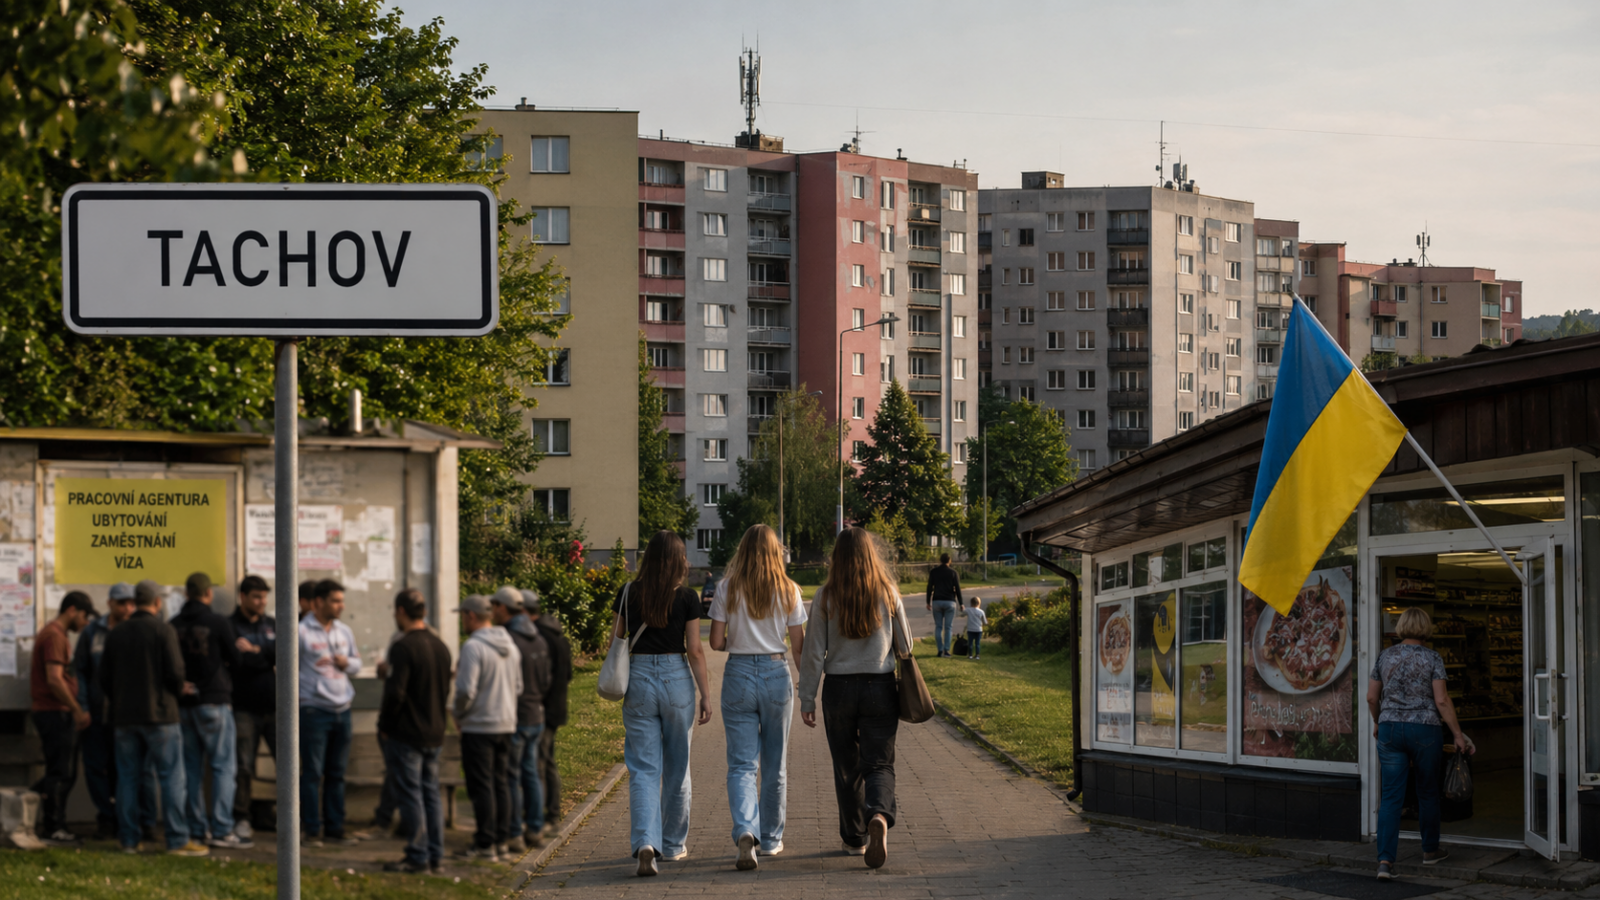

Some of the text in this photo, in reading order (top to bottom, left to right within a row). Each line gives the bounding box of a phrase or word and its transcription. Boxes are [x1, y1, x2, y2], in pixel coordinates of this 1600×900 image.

[147, 229, 412, 287] TACHOV
[68, 490, 210, 506] PRACOVNÍ AGENTURA
[92, 511, 167, 527] UBYTOVÁNÍ
[91, 532, 176, 548] ZAMĚSTNÁNÍ
[114, 553, 144, 569] VÍZA
